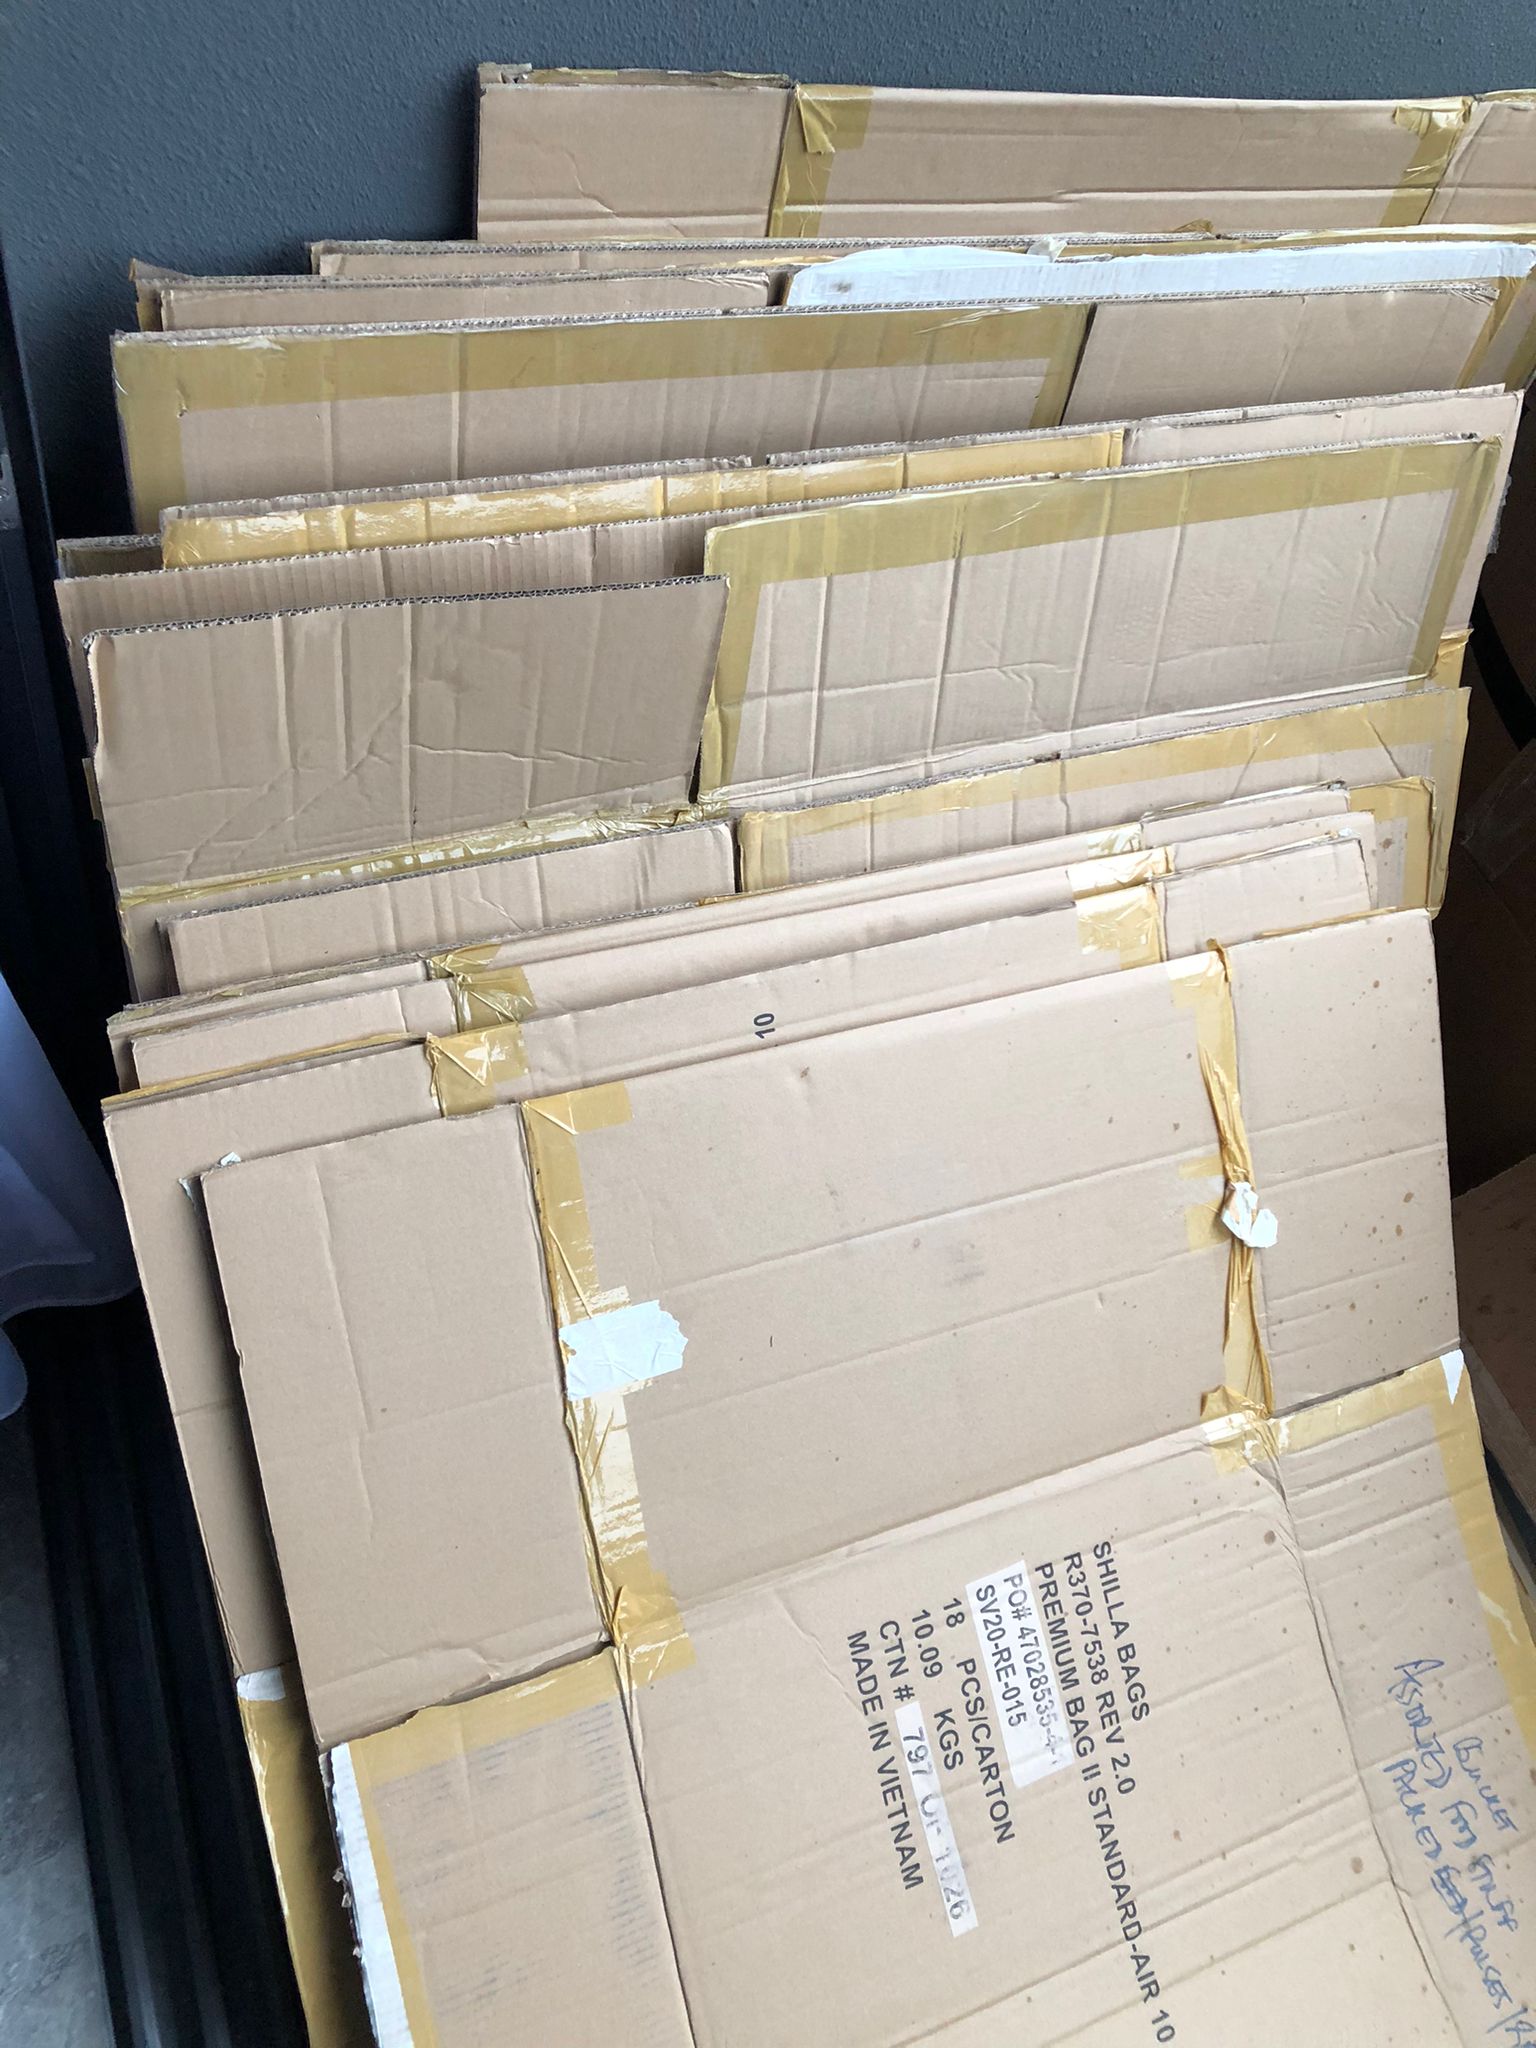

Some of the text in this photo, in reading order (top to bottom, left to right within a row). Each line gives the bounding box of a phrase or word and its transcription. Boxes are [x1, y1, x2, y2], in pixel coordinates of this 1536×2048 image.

[753, 1013, 775, 1039] 10
[879, 1620, 909, 1679] CTN
[893, 1685, 916, 1702] #
[912, 1608, 963, 1771] 10.09 KGS
[975, 1584, 1028, 1727] SV20-RE-015
[1064, 1552, 1135, 1794] R370-7538 REV 2.0
[1093, 1541, 1150, 1721] SHILLA BAGS
[847, 1631, 923, 1890] MADE IN VIETNAM
[943, 1597, 1015, 1844] 18 PCS/CARTON
[1035, 1562, 1079, 1692] PREMIUM
[1065, 1696, 1094, 1757] BAG
[1088, 1787, 1161, 2003] STANDARD-AIR
[1152, 2009, 1175, 2043] 10
